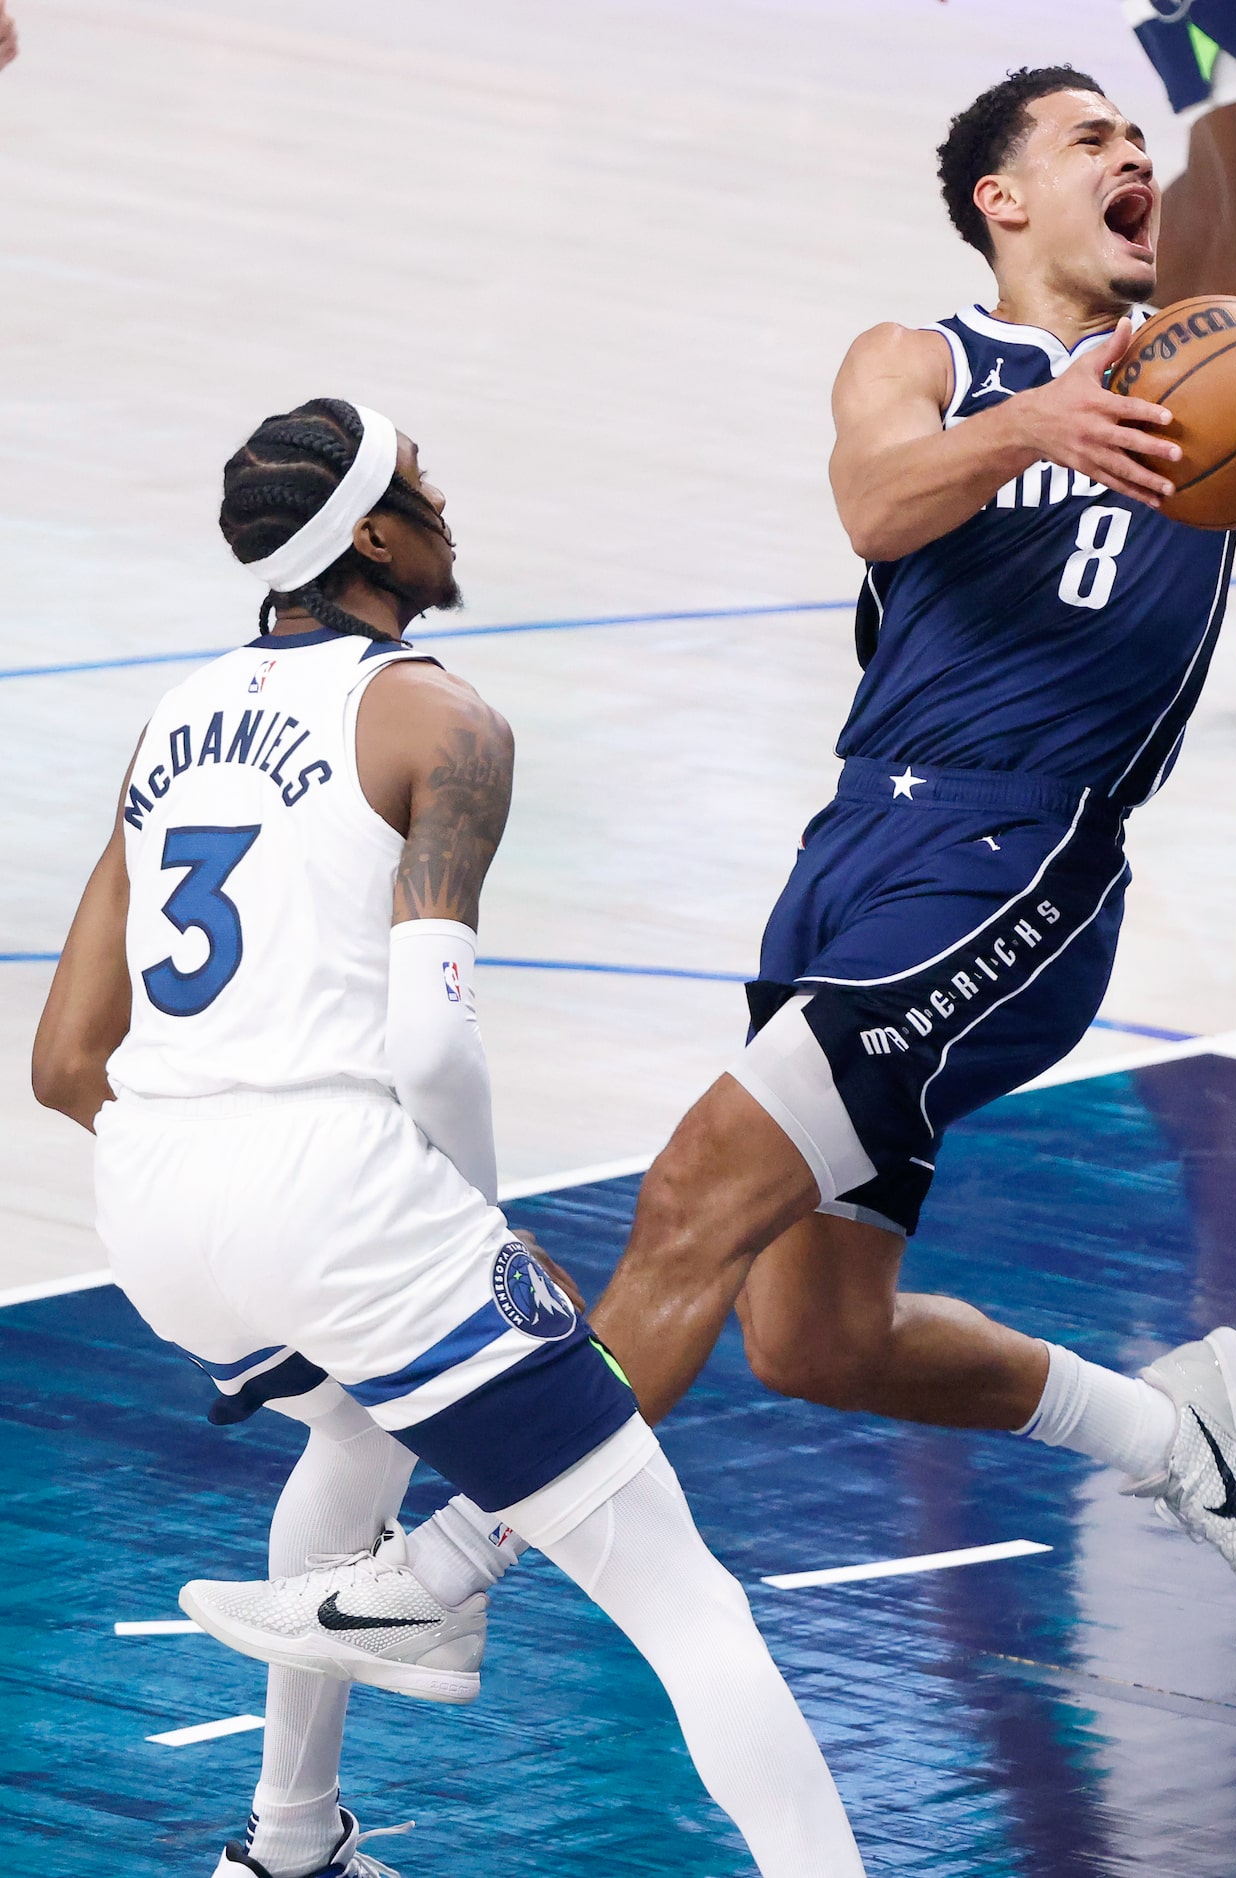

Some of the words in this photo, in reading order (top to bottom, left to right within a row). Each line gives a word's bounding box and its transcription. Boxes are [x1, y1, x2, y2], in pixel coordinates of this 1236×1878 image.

[1058, 505, 1133, 610] 8
[141, 823, 262, 1018] 3
[859, 900, 1061, 1056] MAVERICKS
[494, 1251, 524, 1327] MINNESOTA
